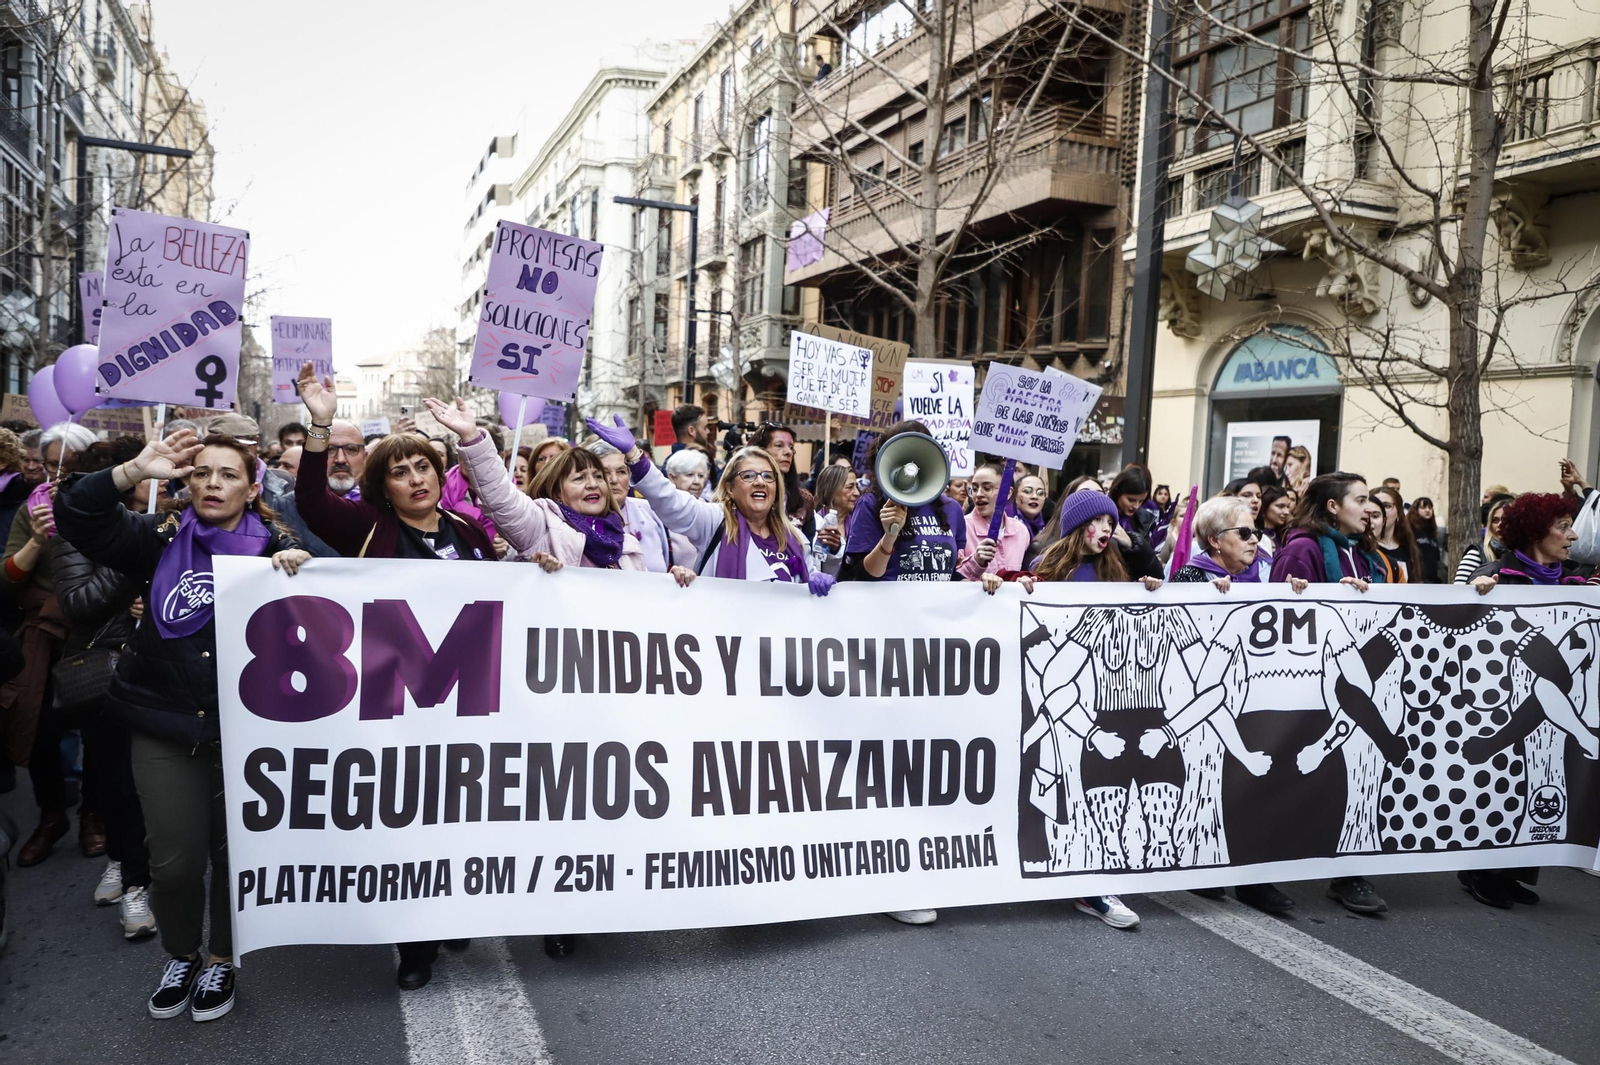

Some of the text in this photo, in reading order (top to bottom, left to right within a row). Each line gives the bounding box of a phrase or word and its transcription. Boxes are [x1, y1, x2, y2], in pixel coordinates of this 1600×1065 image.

[114, 223, 248, 280] La BELLEZA
[497, 226, 599, 277] PROMESAS
[112, 257, 164, 288] está
[176, 280, 213, 298] en
[119, 292, 157, 316] la
[482, 301, 584, 348] SOLUCIONES
[98, 300, 237, 387] DIGNIDAD
[295, 342, 312, 354] el
[796, 336, 860, 366] HOY VAS A
[497, 342, 552, 376] SÍ
[793, 360, 867, 387] SER LA MUJER
[1234, 358, 1319, 383] ABANCA
[792, 376, 814, 392] QUE
[817, 380, 827, 392] TE
[846, 386, 858, 398] LA
[874, 376, 894, 394] STOP
[930, 370, 944, 394] SI
[1018, 375, 1052, 394] SOY LA
[796, 392, 820, 404] GANA
[838, 398, 859, 411] SER
[910, 396, 943, 416] VUELVE
[948, 396, 964, 418] LA
[1004, 388, 1062, 413] MAESTRA
[946, 417, 972, 429] MEDIA
[995, 405, 1010, 420] DE
[1012, 408, 1034, 424] LAS
[1035, 414, 1068, 434] NIÑAS
[974, 421, 995, 437] QUE
[1031, 436, 1065, 454] TOCARÁS
[1249, 604, 1318, 650] 8M
[238, 595, 1001, 722] 8M UNIDAS Y LUCHANDO
[242, 737, 997, 832] SEGUIREMOS AVANZANDO
[238, 858, 452, 912] PLATAFORMA
[464, 856, 516, 896] 8M
[526, 854, 544, 894] /
[554, 854, 614, 892] 25N
[644, 845, 796, 890] FEMINISMO
[802, 838, 910, 880] UNITARIO
[919, 825, 998, 871] GRANÁ
